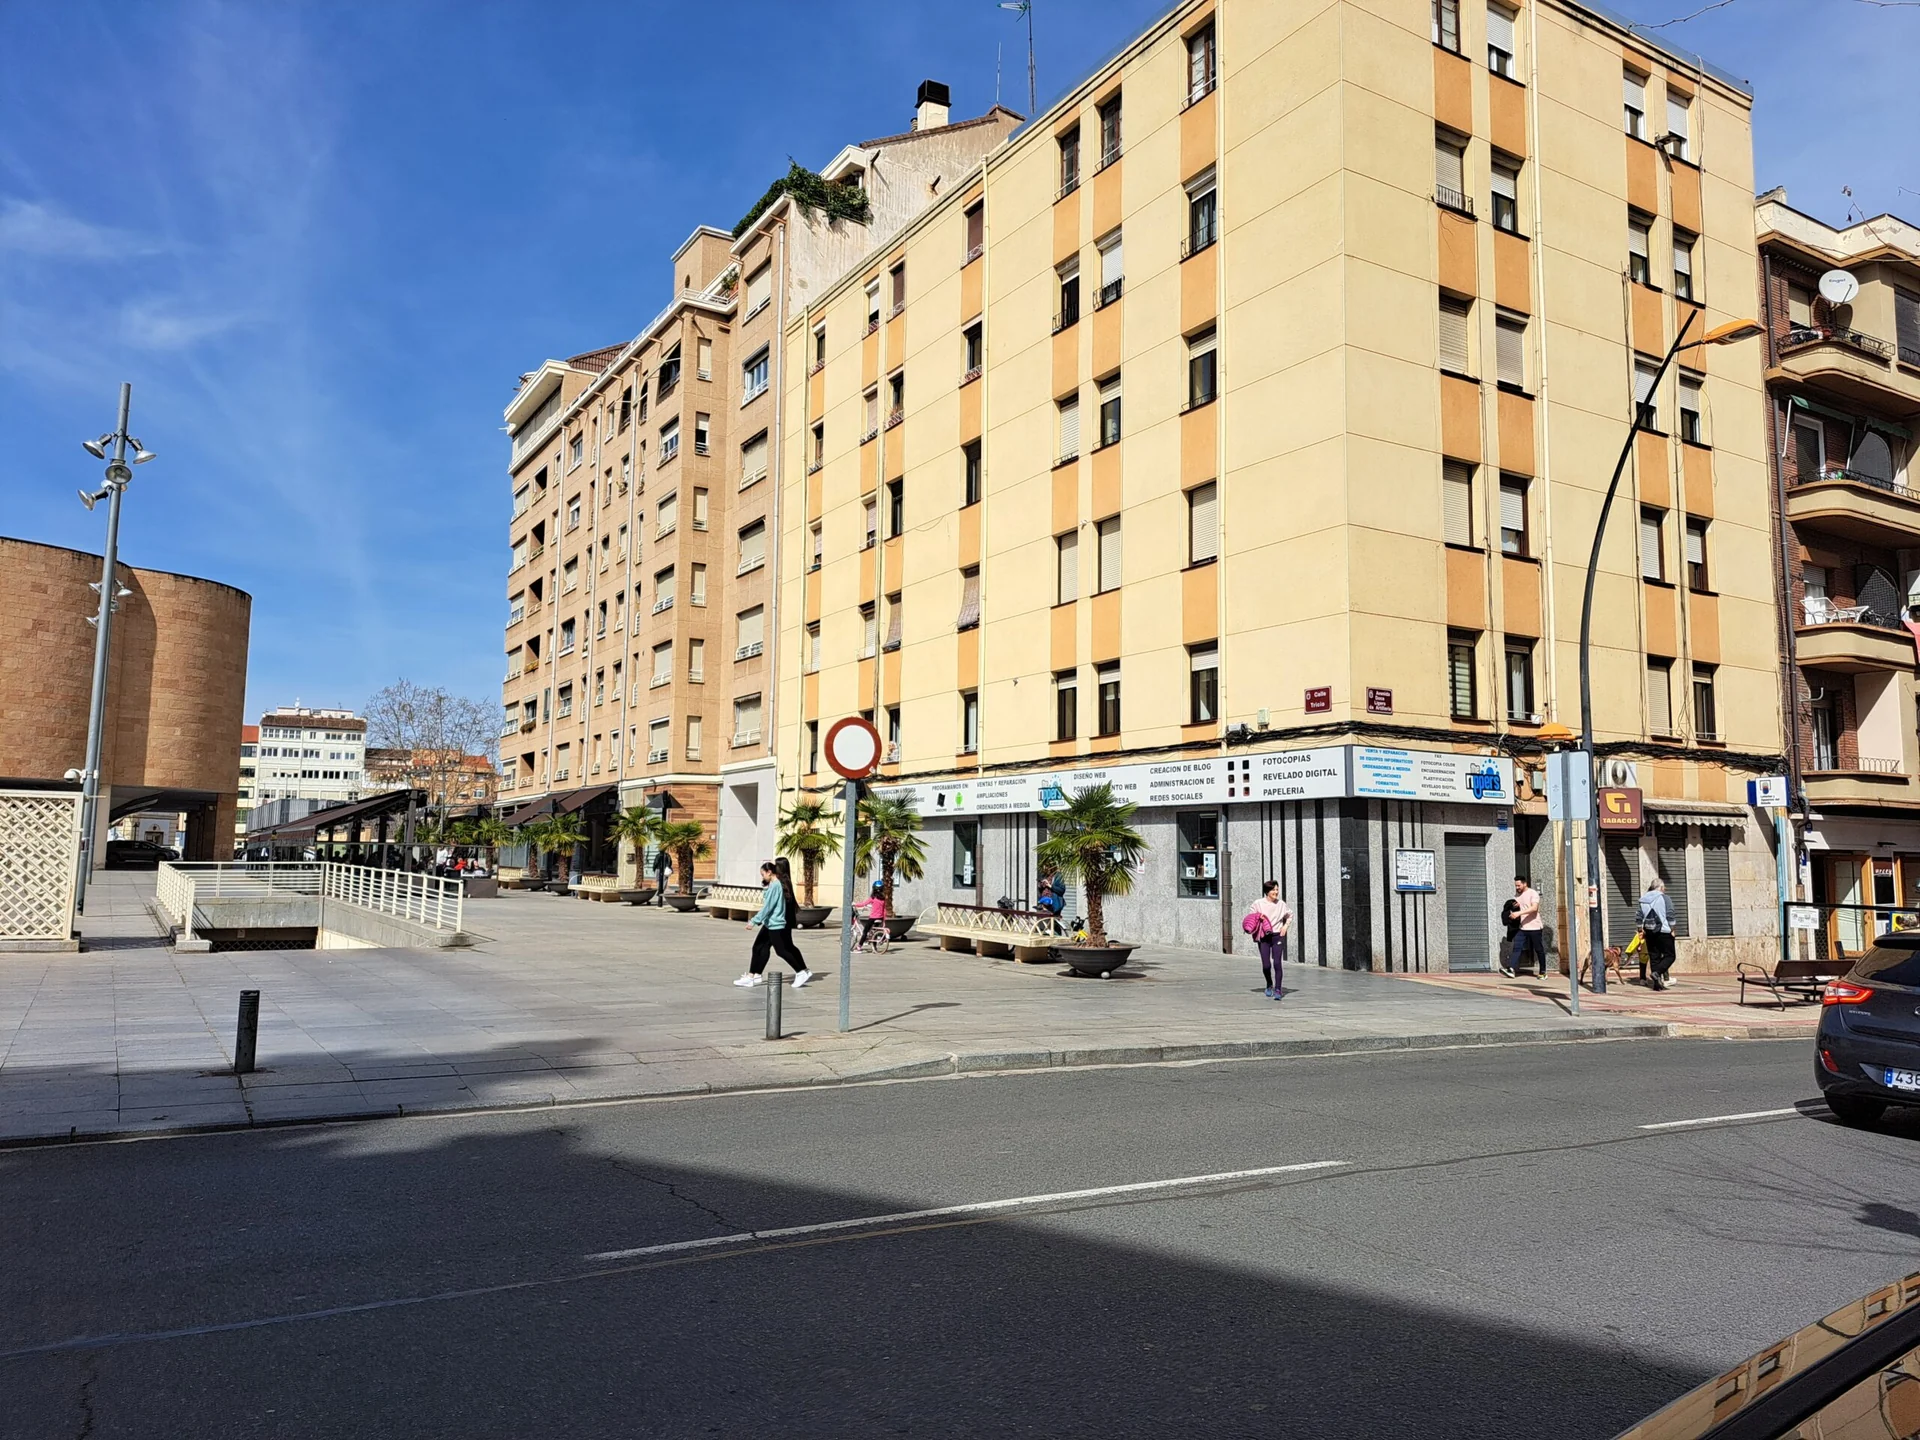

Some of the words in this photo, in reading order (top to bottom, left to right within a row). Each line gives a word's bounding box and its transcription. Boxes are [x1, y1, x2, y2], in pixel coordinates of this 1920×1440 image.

[1262, 754, 1311, 765] FOTOCOPIAS
[1150, 766, 1181, 774] CREACION
[1194, 763, 1211, 771] BLOG
[1074, 772, 1092, 780] DISEÑO
[1263, 770, 1303, 781] REVELADO
[1306, 768, 1337, 778] DIGITAL
[1150, 778, 1204, 788] ADMINISTRACION
[1263, 786, 1304, 796] PAPELERIA
[1171, 792, 1203, 801] SOCIALES
